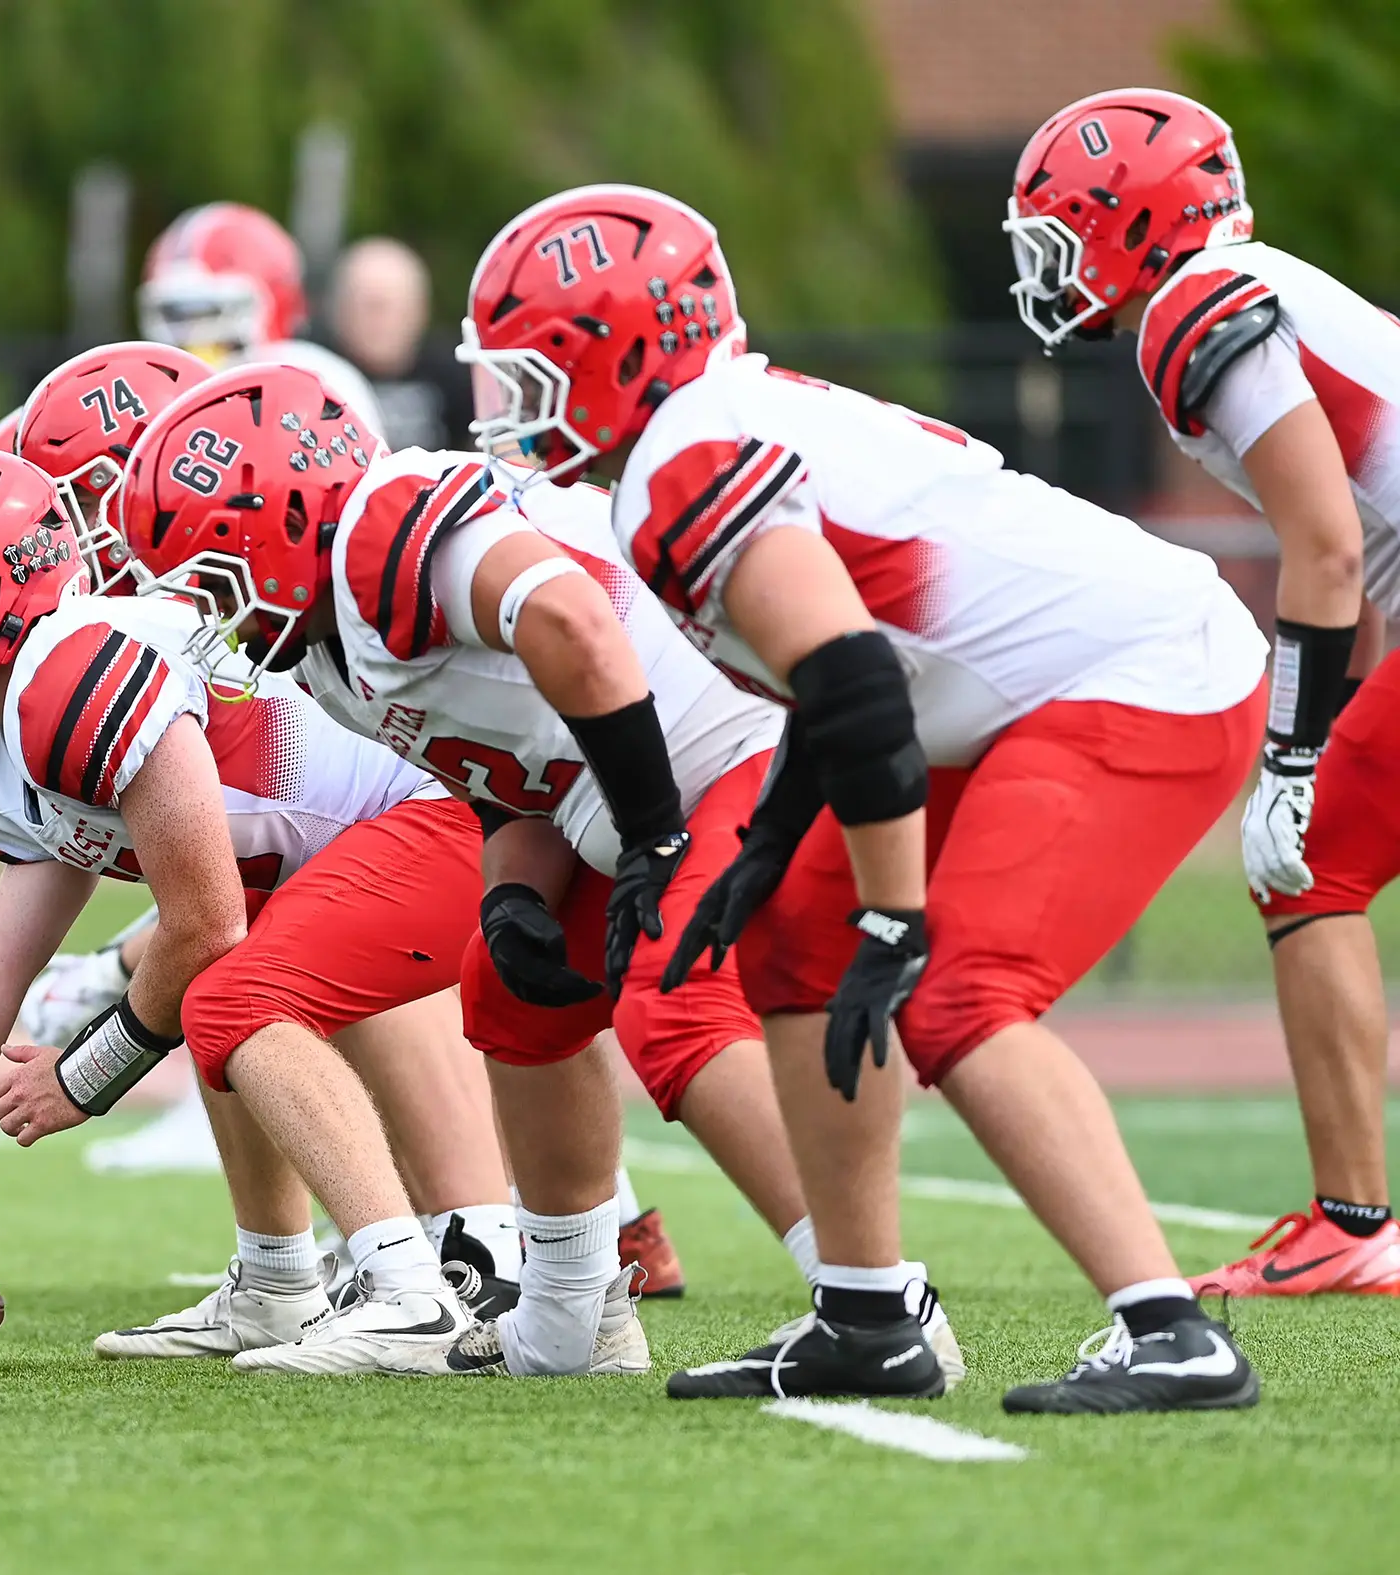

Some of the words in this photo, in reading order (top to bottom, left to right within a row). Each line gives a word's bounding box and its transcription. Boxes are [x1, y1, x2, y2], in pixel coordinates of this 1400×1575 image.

[1077, 117, 1112, 160] 0
[534, 218, 614, 290] 77
[79, 376, 149, 436] 74
[169, 427, 243, 497] 62
[1322, 1200, 1388, 1219] BATTLE
